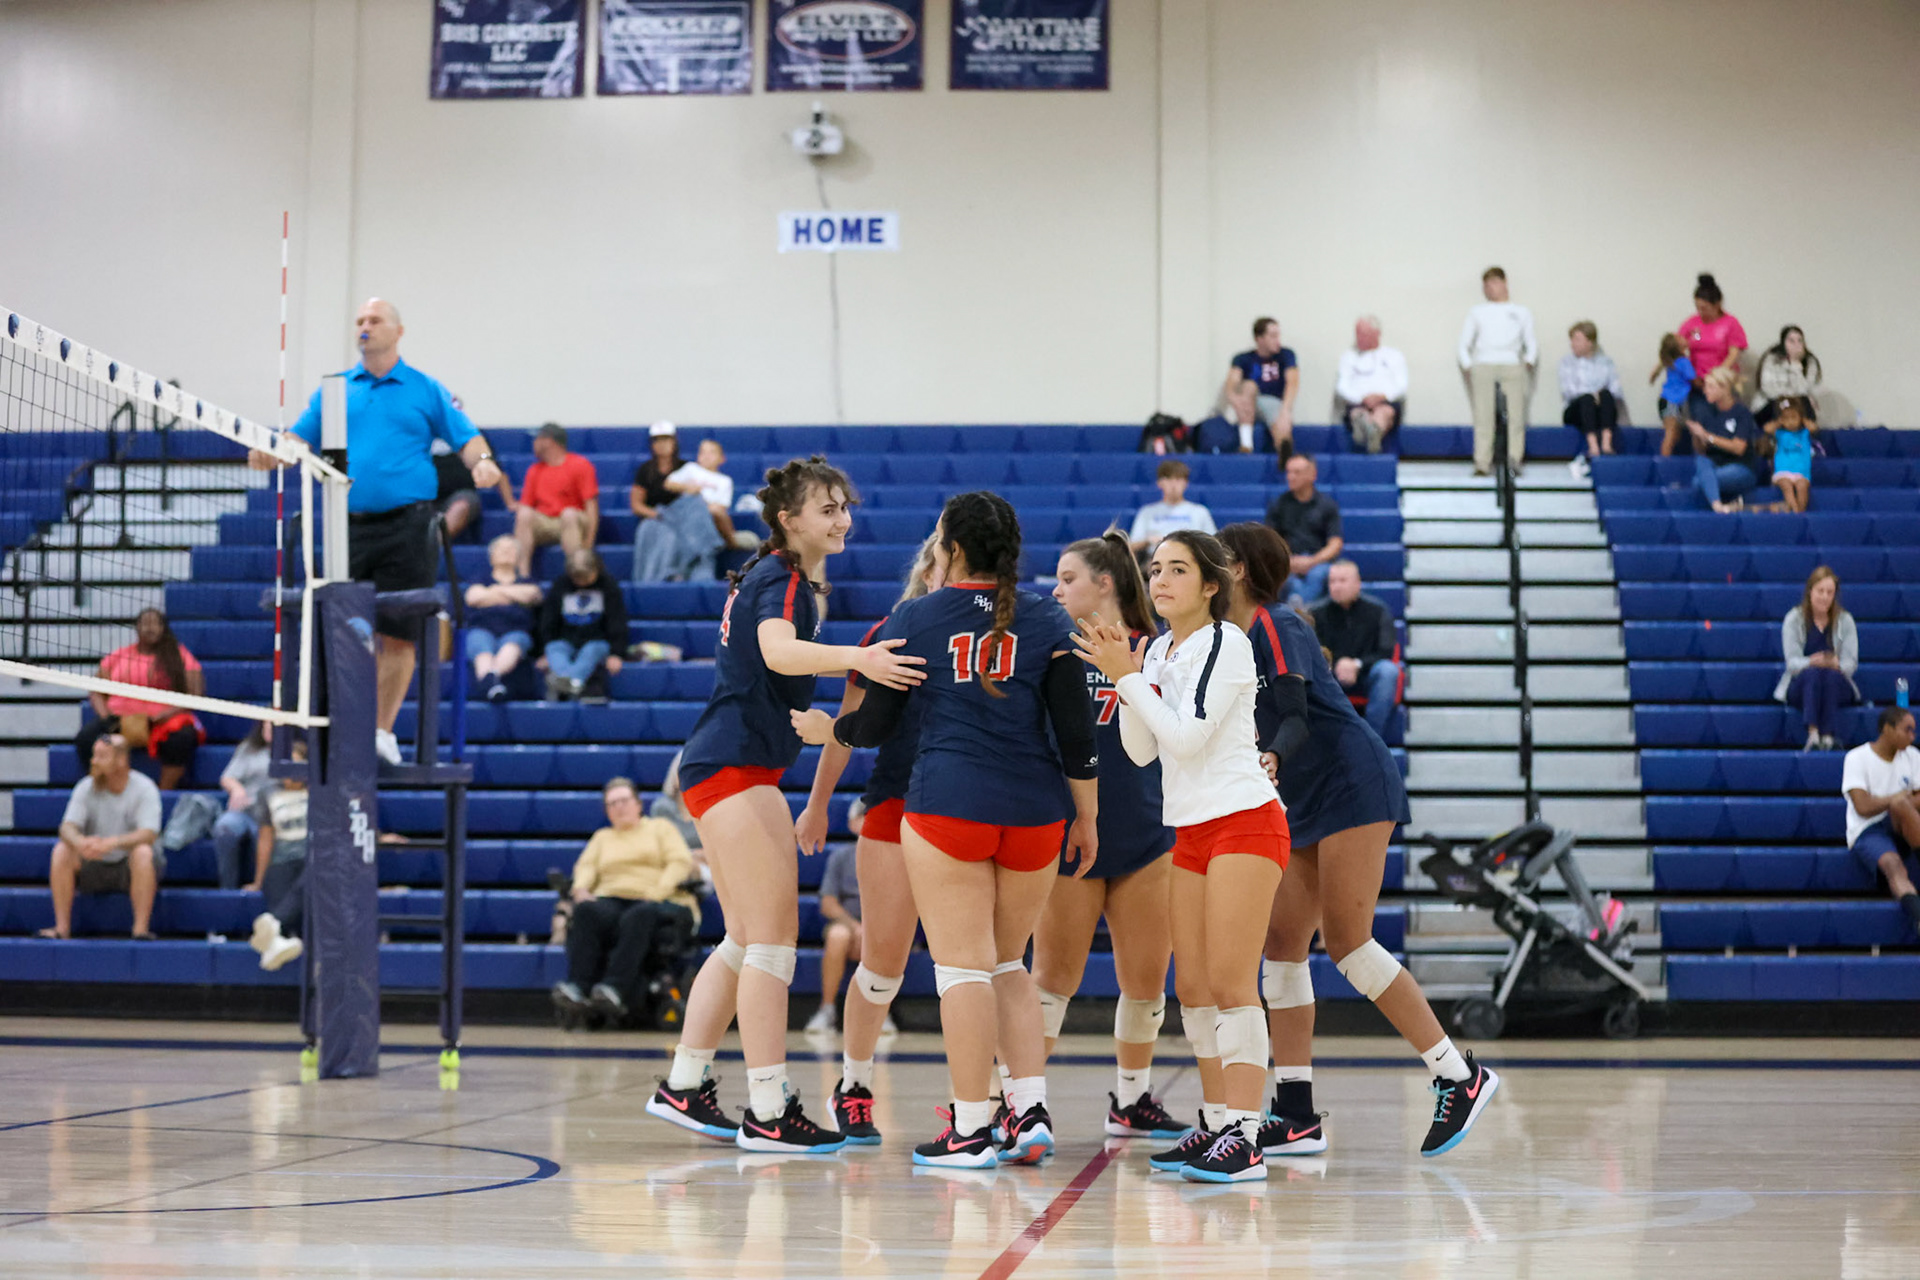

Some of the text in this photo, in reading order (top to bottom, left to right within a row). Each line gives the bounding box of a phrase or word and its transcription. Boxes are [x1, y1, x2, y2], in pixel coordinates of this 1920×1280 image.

[490, 43, 528, 62] LLC
[794, 218, 884, 243] HOME
[948, 630, 1018, 683] 10
